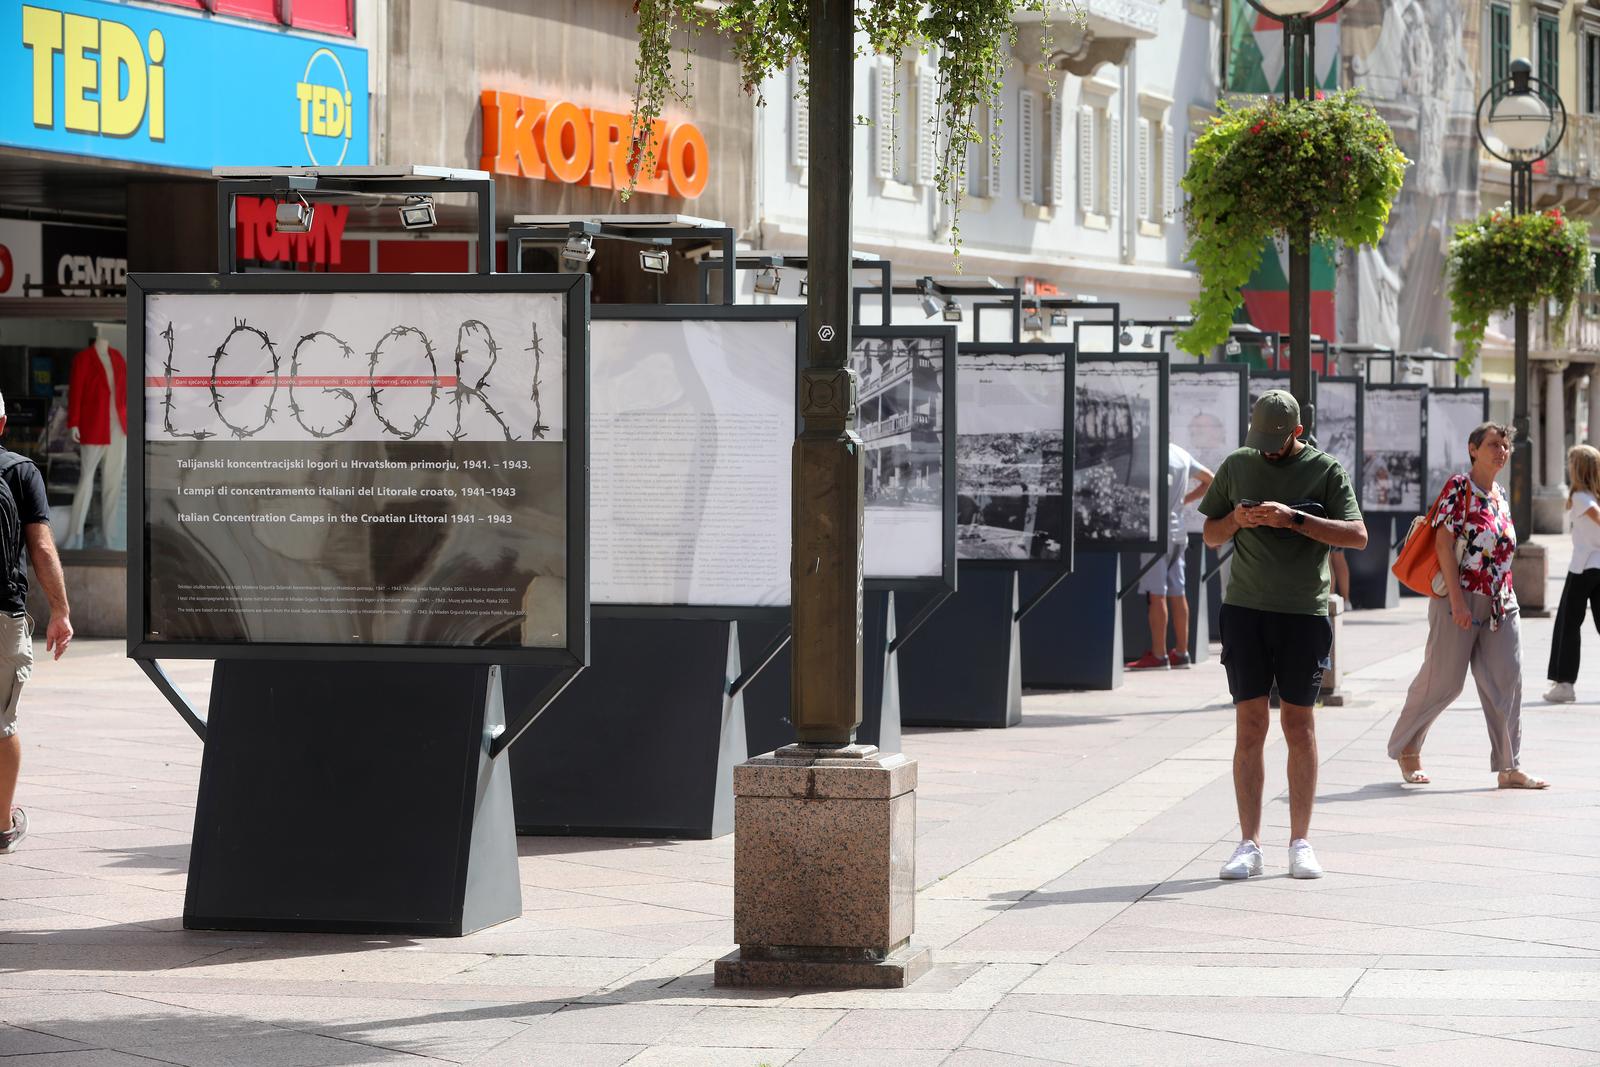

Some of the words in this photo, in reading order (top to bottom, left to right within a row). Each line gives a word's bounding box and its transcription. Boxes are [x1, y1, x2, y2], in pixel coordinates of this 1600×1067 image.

[22, 5, 166, 143] TEDi
[296, 82, 353, 140] TEDi
[480, 90, 709, 200] KORZO
[159, 316, 550, 441] LOGORI
[177, 459, 224, 470] Talijanski
[227, 459, 304, 470] koncentracijski
[307, 459, 338, 471] logori
[351, 459, 407, 469] Hrvatskom
[410, 460, 459, 471] primorju,
[463, 460, 491, 469] 1941.
[502, 460, 532, 470] 1943.
[177, 487, 180, 496] I
[183, 487, 214, 498] campi
[217, 487, 228, 496] di
[230, 487, 316, 496] concentramento
[318, 487, 354, 496] italiani
[358, 487, 374, 496] del
[377, 487, 417, 497] Litorale
[420, 487, 457, 498] croato,
[461, 487, 516, 497] 1941–1943
[177, 513, 210, 522] Italian
[213, 513, 286, 523] Concentration
[289, 513, 325, 525] Camps
[327, 513, 338, 523] in
[340, 513, 358, 523] the
[361, 514, 406, 523] Croatian
[409, 514, 448, 523] Littoral
[451, 514, 475, 524] 1941
[487, 514, 512, 524] 1943
